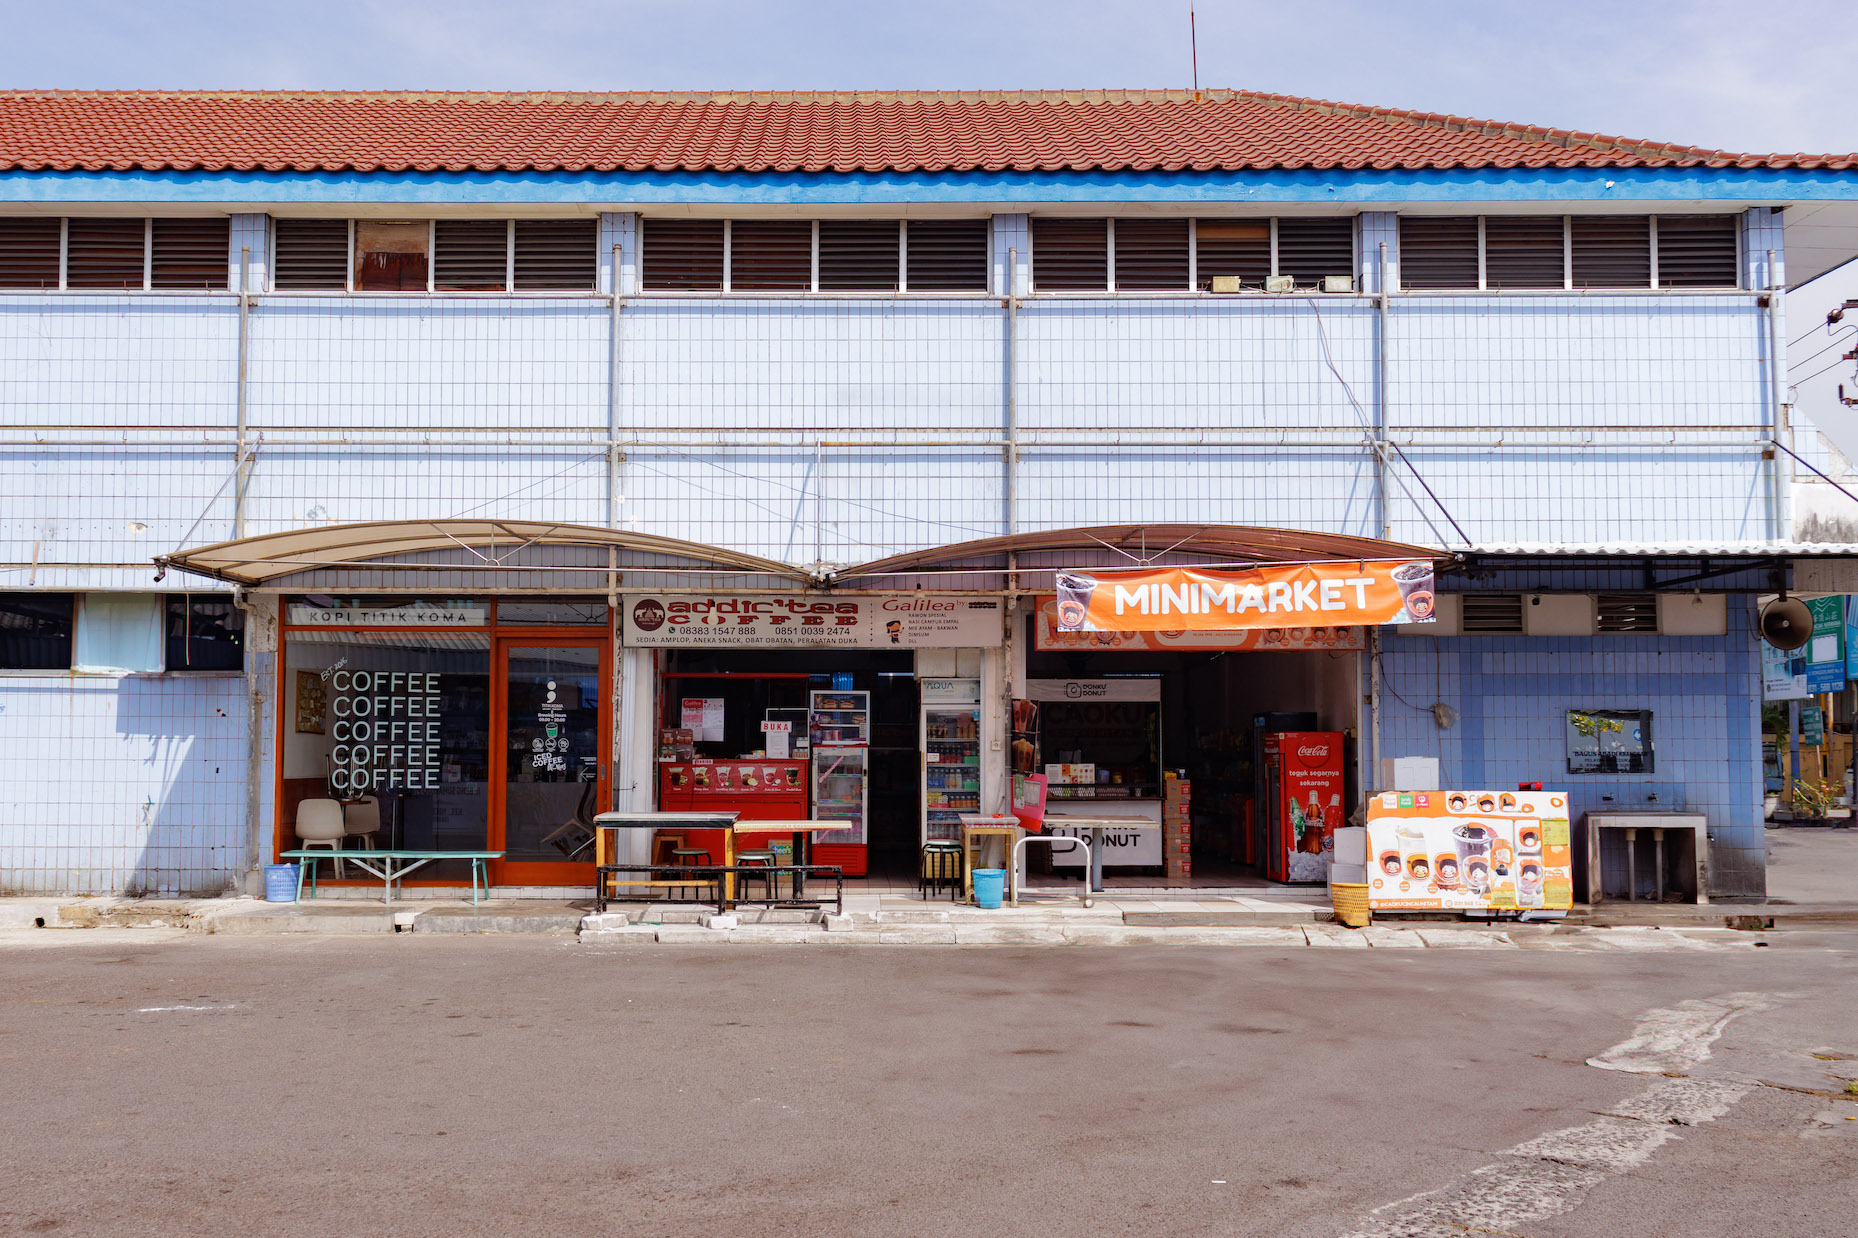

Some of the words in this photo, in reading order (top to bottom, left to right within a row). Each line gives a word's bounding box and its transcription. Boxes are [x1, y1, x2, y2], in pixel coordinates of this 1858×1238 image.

[1114, 577, 1375, 615] MINIMARKET
[667, 598, 858, 614] addic'tea
[882, 600, 955, 611] Galilea
[310, 612, 350, 622] KOPI
[361, 612, 407, 622] TITIK
[418, 613, 467, 622] KOMA
[667, 614, 858, 625] COFFEE
[680, 627, 709, 635] 08383
[712, 627, 735, 635] 1547
[738, 627, 756, 635] 888
[775, 627, 797, 635] 0851
[801, 627, 824, 635] 0039
[827, 627, 850, 635] 2474
[332, 671, 441, 693] COFFEE
[332, 696, 441, 717] COFFEE
[332, 720, 441, 742] COFFEE
[764, 723, 789, 731] BUKA
[332, 744, 440, 766] COFFEE
[534, 752, 552, 761] ICED
[1298, 745, 1330, 756] Coca-Cola
[532, 756, 563, 768] COFFEE
[332, 768, 440, 789] COFFEE
[1081, 834, 1141, 847] DNUT
